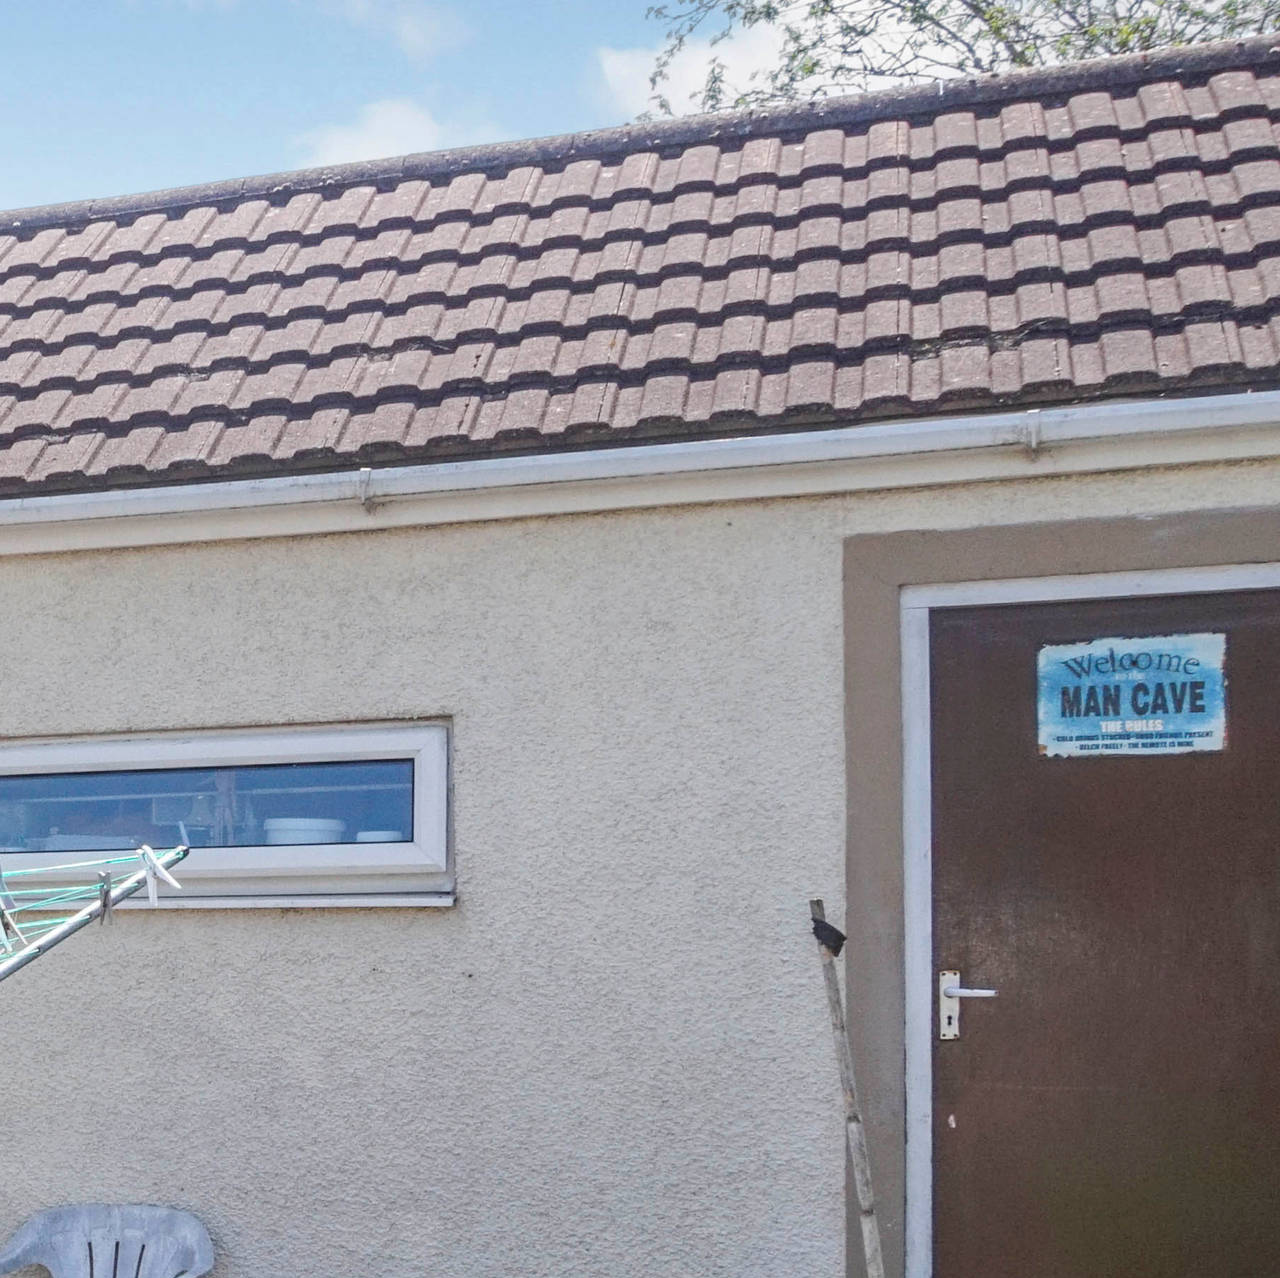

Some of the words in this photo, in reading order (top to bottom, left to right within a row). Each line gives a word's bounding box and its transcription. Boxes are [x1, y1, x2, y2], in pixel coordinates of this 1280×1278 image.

[1062, 648, 1200, 679] Welcome
[1061, 685, 1121, 718] MAN
[1131, 681, 1206, 716] CAVE
[1101, 720, 1123, 732] THE
[1125, 719, 1164, 731] RULES
